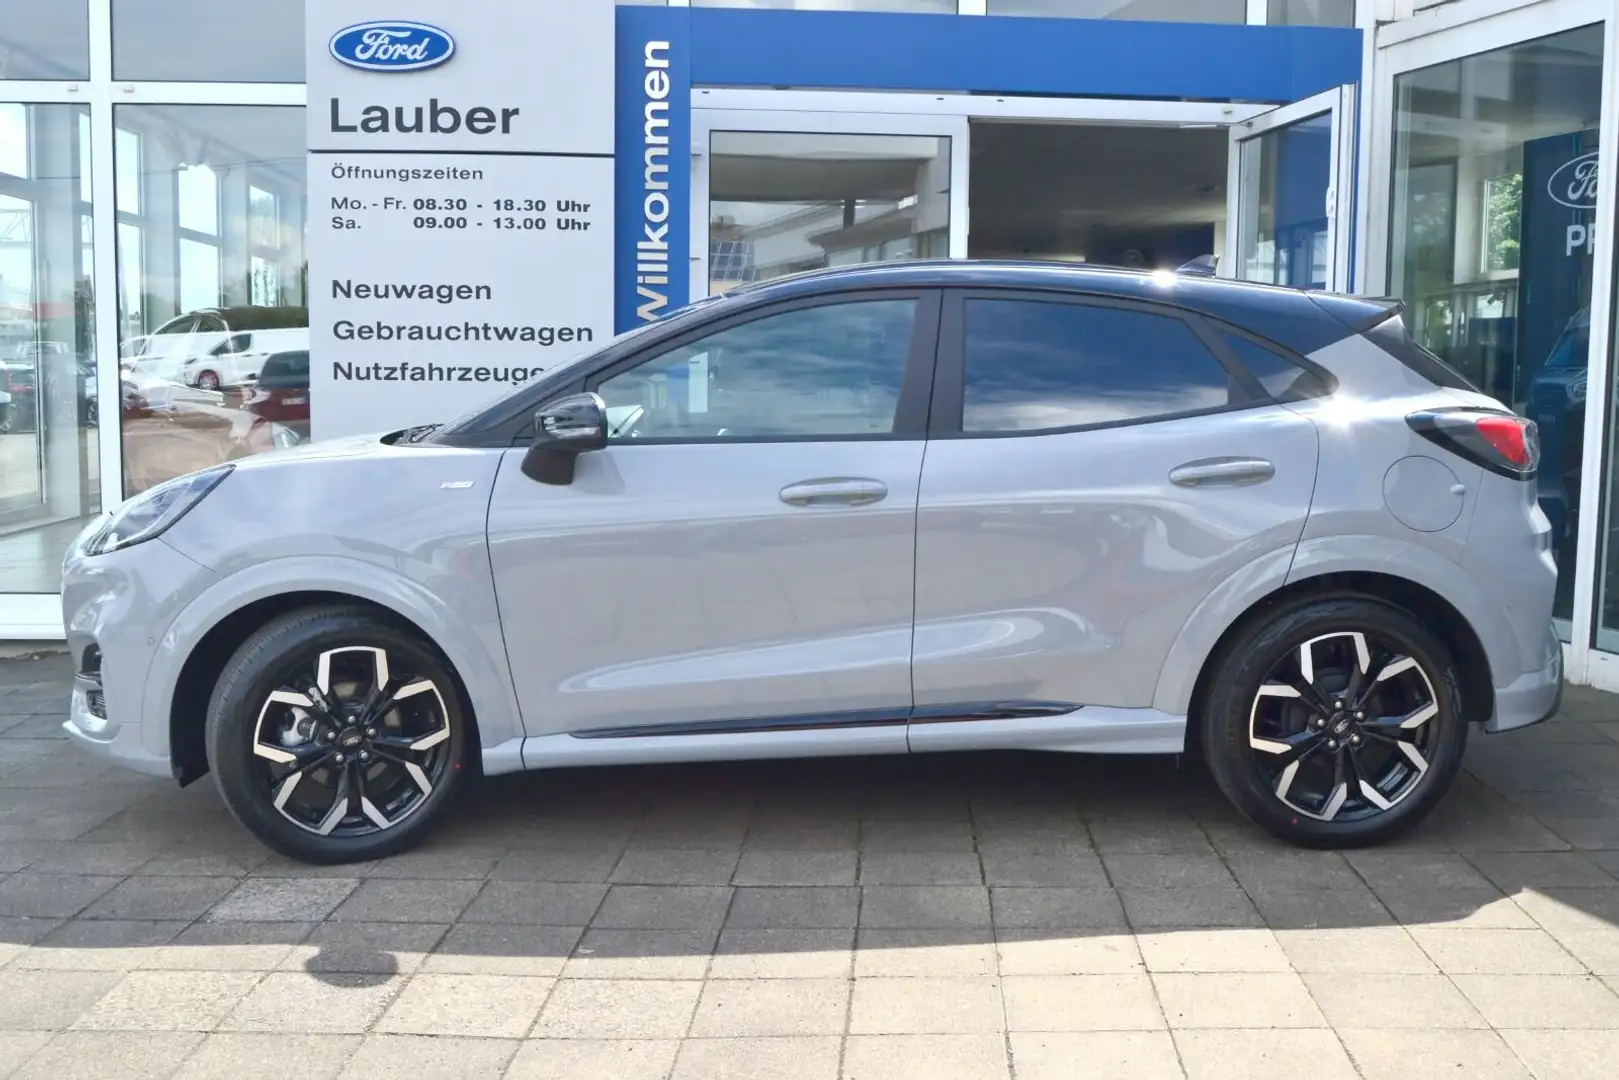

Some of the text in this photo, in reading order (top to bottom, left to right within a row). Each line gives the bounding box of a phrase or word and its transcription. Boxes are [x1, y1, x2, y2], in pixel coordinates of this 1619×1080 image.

[354, 28, 430, 60] Ford
[330, 97, 520, 135] Lauber
[331, 162, 483, 182] Öffnungszeiten
[637, 40, 670, 322] Willkommen
[331, 196, 367, 210] Mo.
[383, 196, 406, 210] Fr.
[413, 198, 468, 211] 08.30
[493, 199, 547, 212] 18.30
[556, 199, 591, 213] Uhr
[331, 216, 362, 230] Sa.
[413, 216, 468, 229] 09.00
[493, 216, 547, 230] 13.00
[556, 217, 591, 231] Uhr
[331, 279, 492, 304] Neuwagen
[332, 319, 593, 347] Gebrauchtwagen
